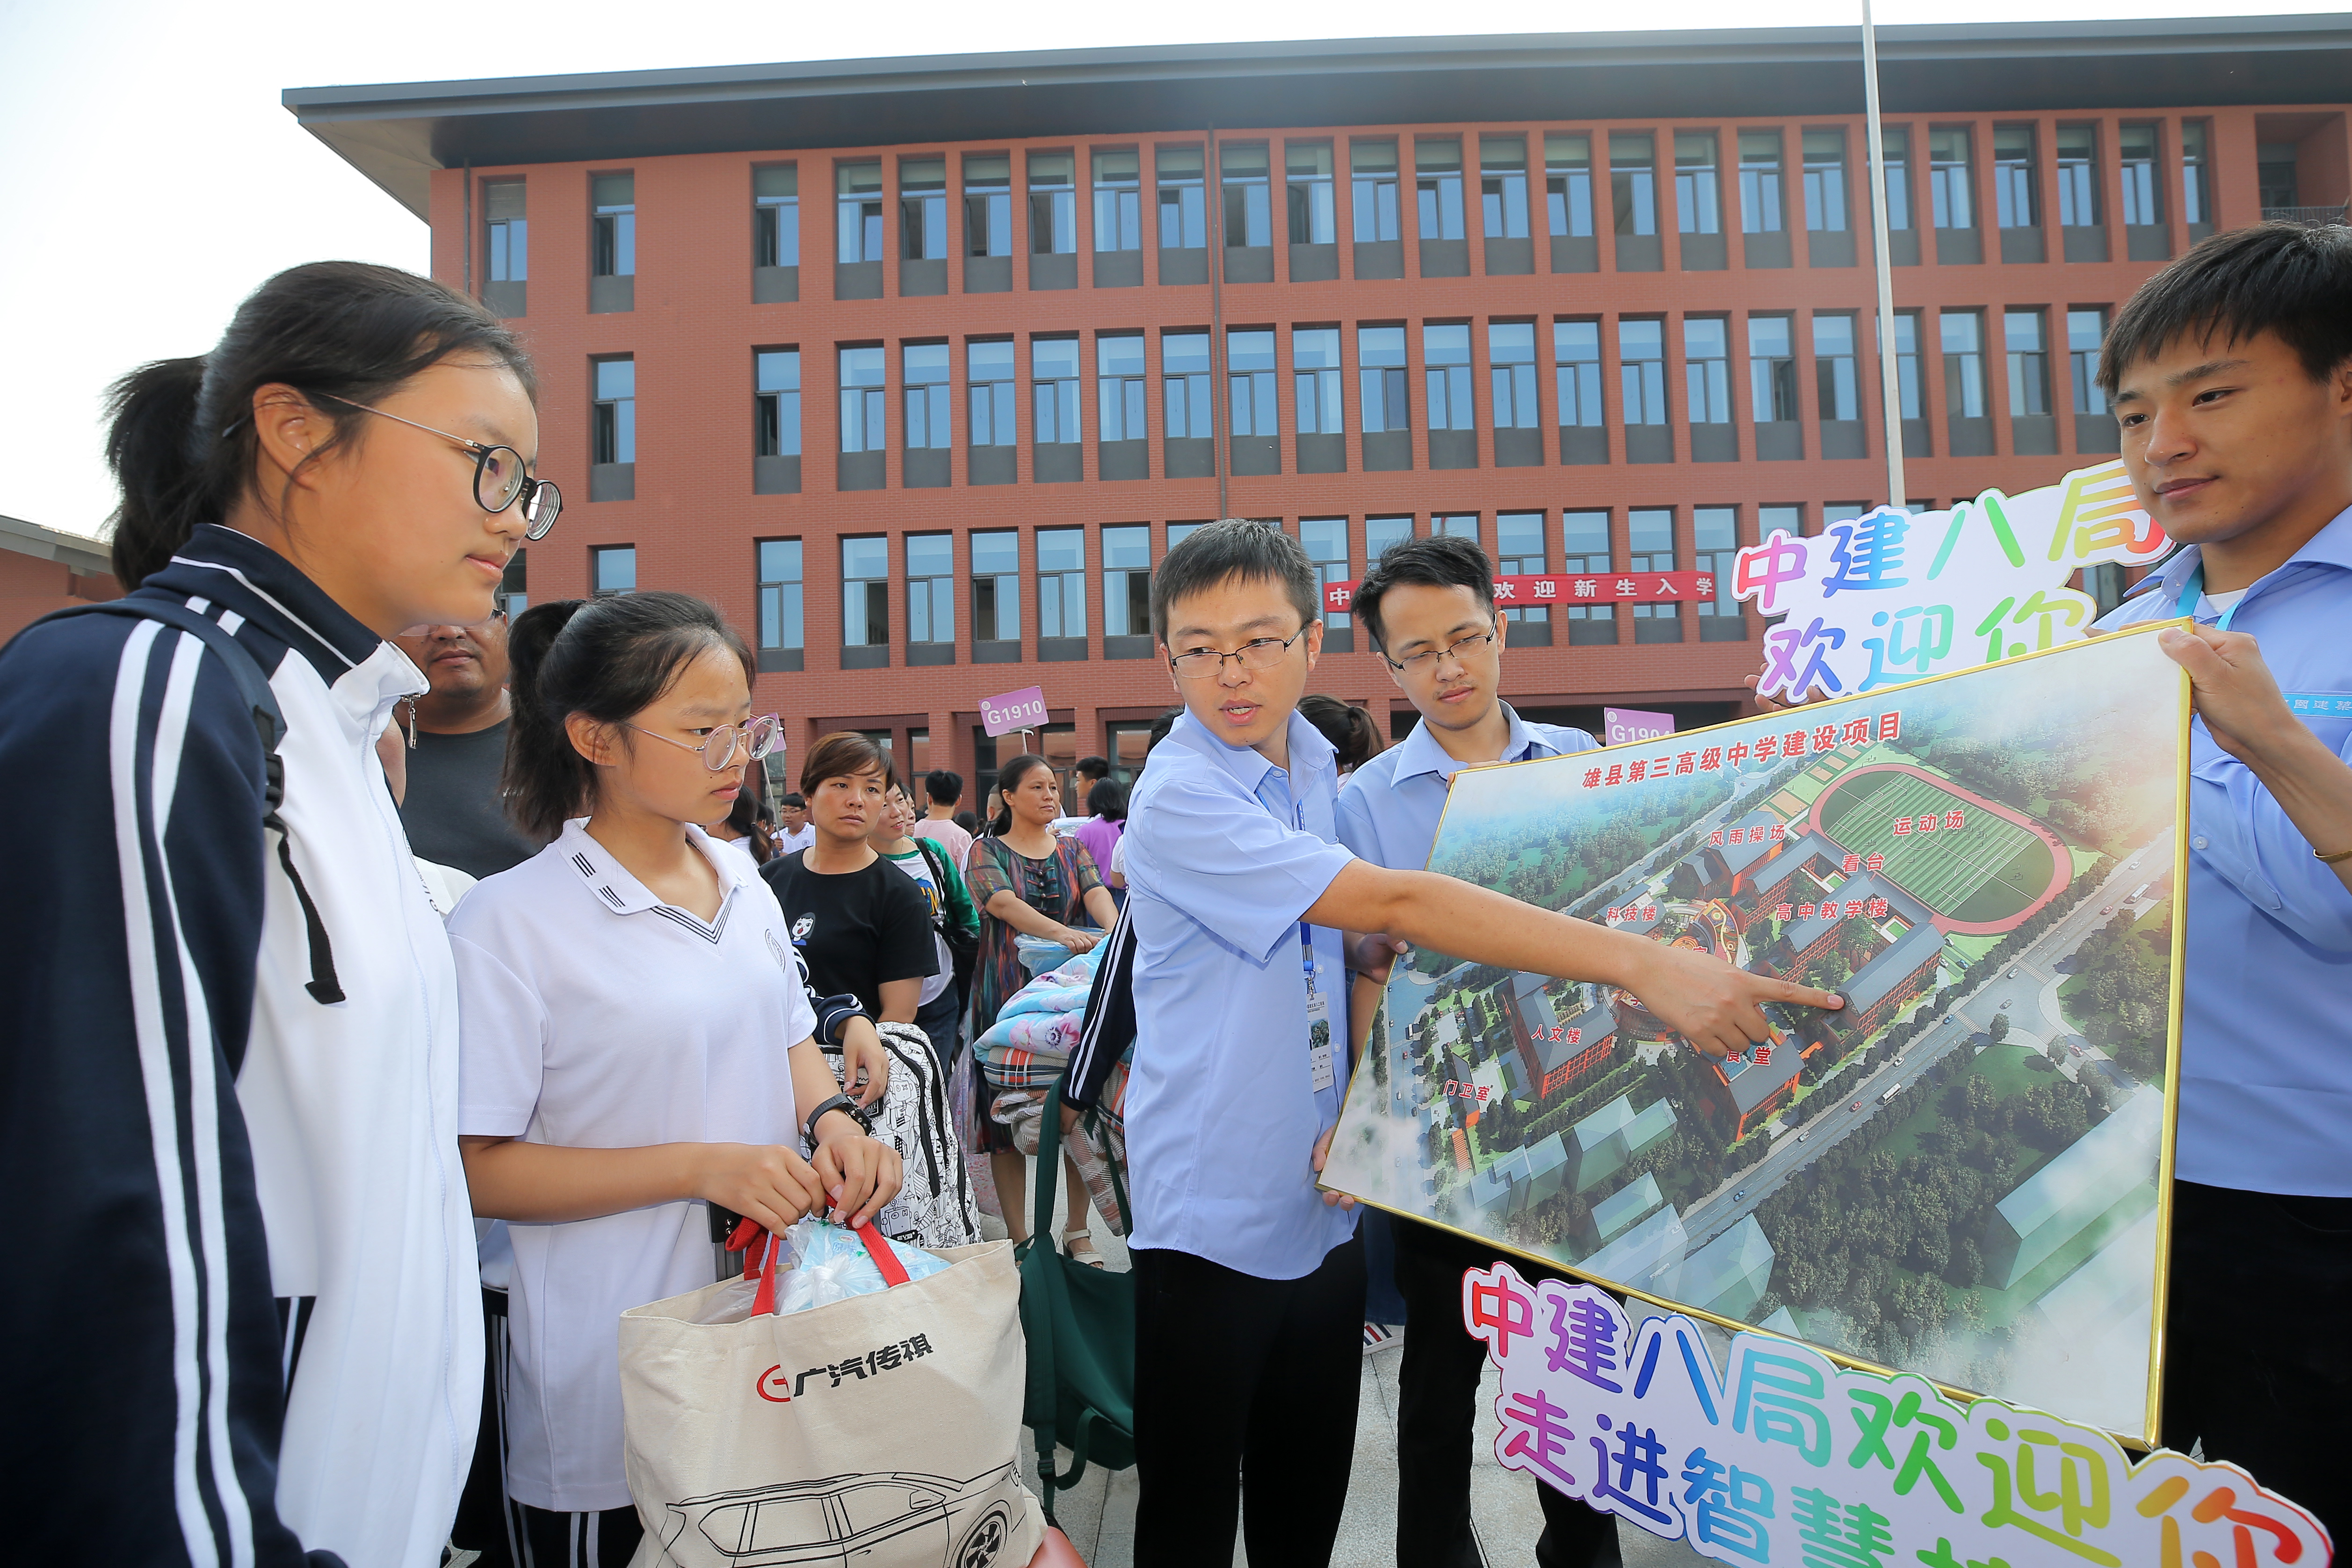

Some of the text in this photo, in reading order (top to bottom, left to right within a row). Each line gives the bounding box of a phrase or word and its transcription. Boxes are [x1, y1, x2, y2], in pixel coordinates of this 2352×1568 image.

[1737, 466, 2164, 609] 中建八局
[1330, 578, 1713, 606] 中 欢迎新生入学
[1763, 591, 2085, 692] 欢迎你
[987, 700, 1042, 724] G1910
[1611, 724, 1670, 742] G190
[1582, 710, 1902, 790] 雄县第三高级中学建设项目
[1708, 823, 1786, 847] 风雨操场
[1893, 809, 1965, 837] 运动场
[1842, 852, 1885, 873] 看台
[1607, 905, 1657, 922] 科技楼
[1775, 897, 1888, 921] 高中教学楼
[1531, 1024, 1582, 1045] 人文楼
[1443, 1079, 1491, 1102] 门卫室
[793, 1333, 934, 1397] 广汽传祺
[1471, 1275, 2302, 1568] 中建八局欢迎你
[1501, 1388, 2012, 1568] 走进智慧
